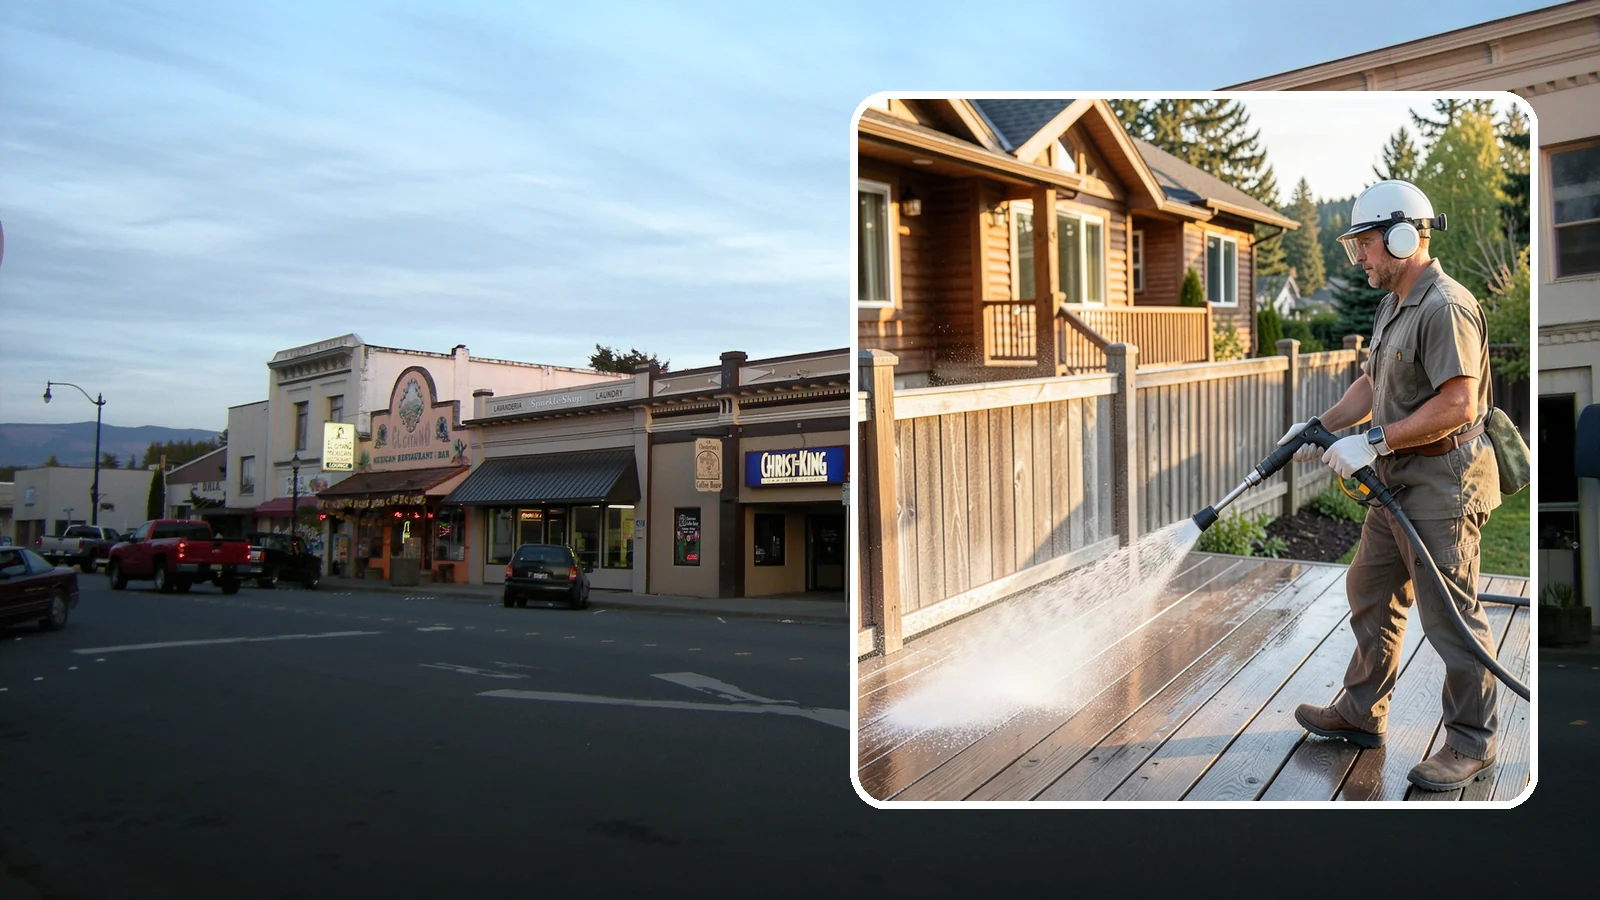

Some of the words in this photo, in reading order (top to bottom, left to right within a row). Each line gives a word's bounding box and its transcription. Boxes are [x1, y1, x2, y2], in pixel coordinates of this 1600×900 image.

[595, 388, 623, 400] LAUNDRY
[493, 402, 522, 412] LAVANDERIA
[530, 396, 561, 409] Sparkle
[561, 394, 583, 405] Shop
[391, 426, 402, 449] EL
[373, 454, 396, 464] MEXICAN
[397, 451, 434, 462] RESTAURANT
[437, 450, 450, 459] BAR
[761, 452, 797, 477] CHRIST
[798, 450, 827, 475] KING
